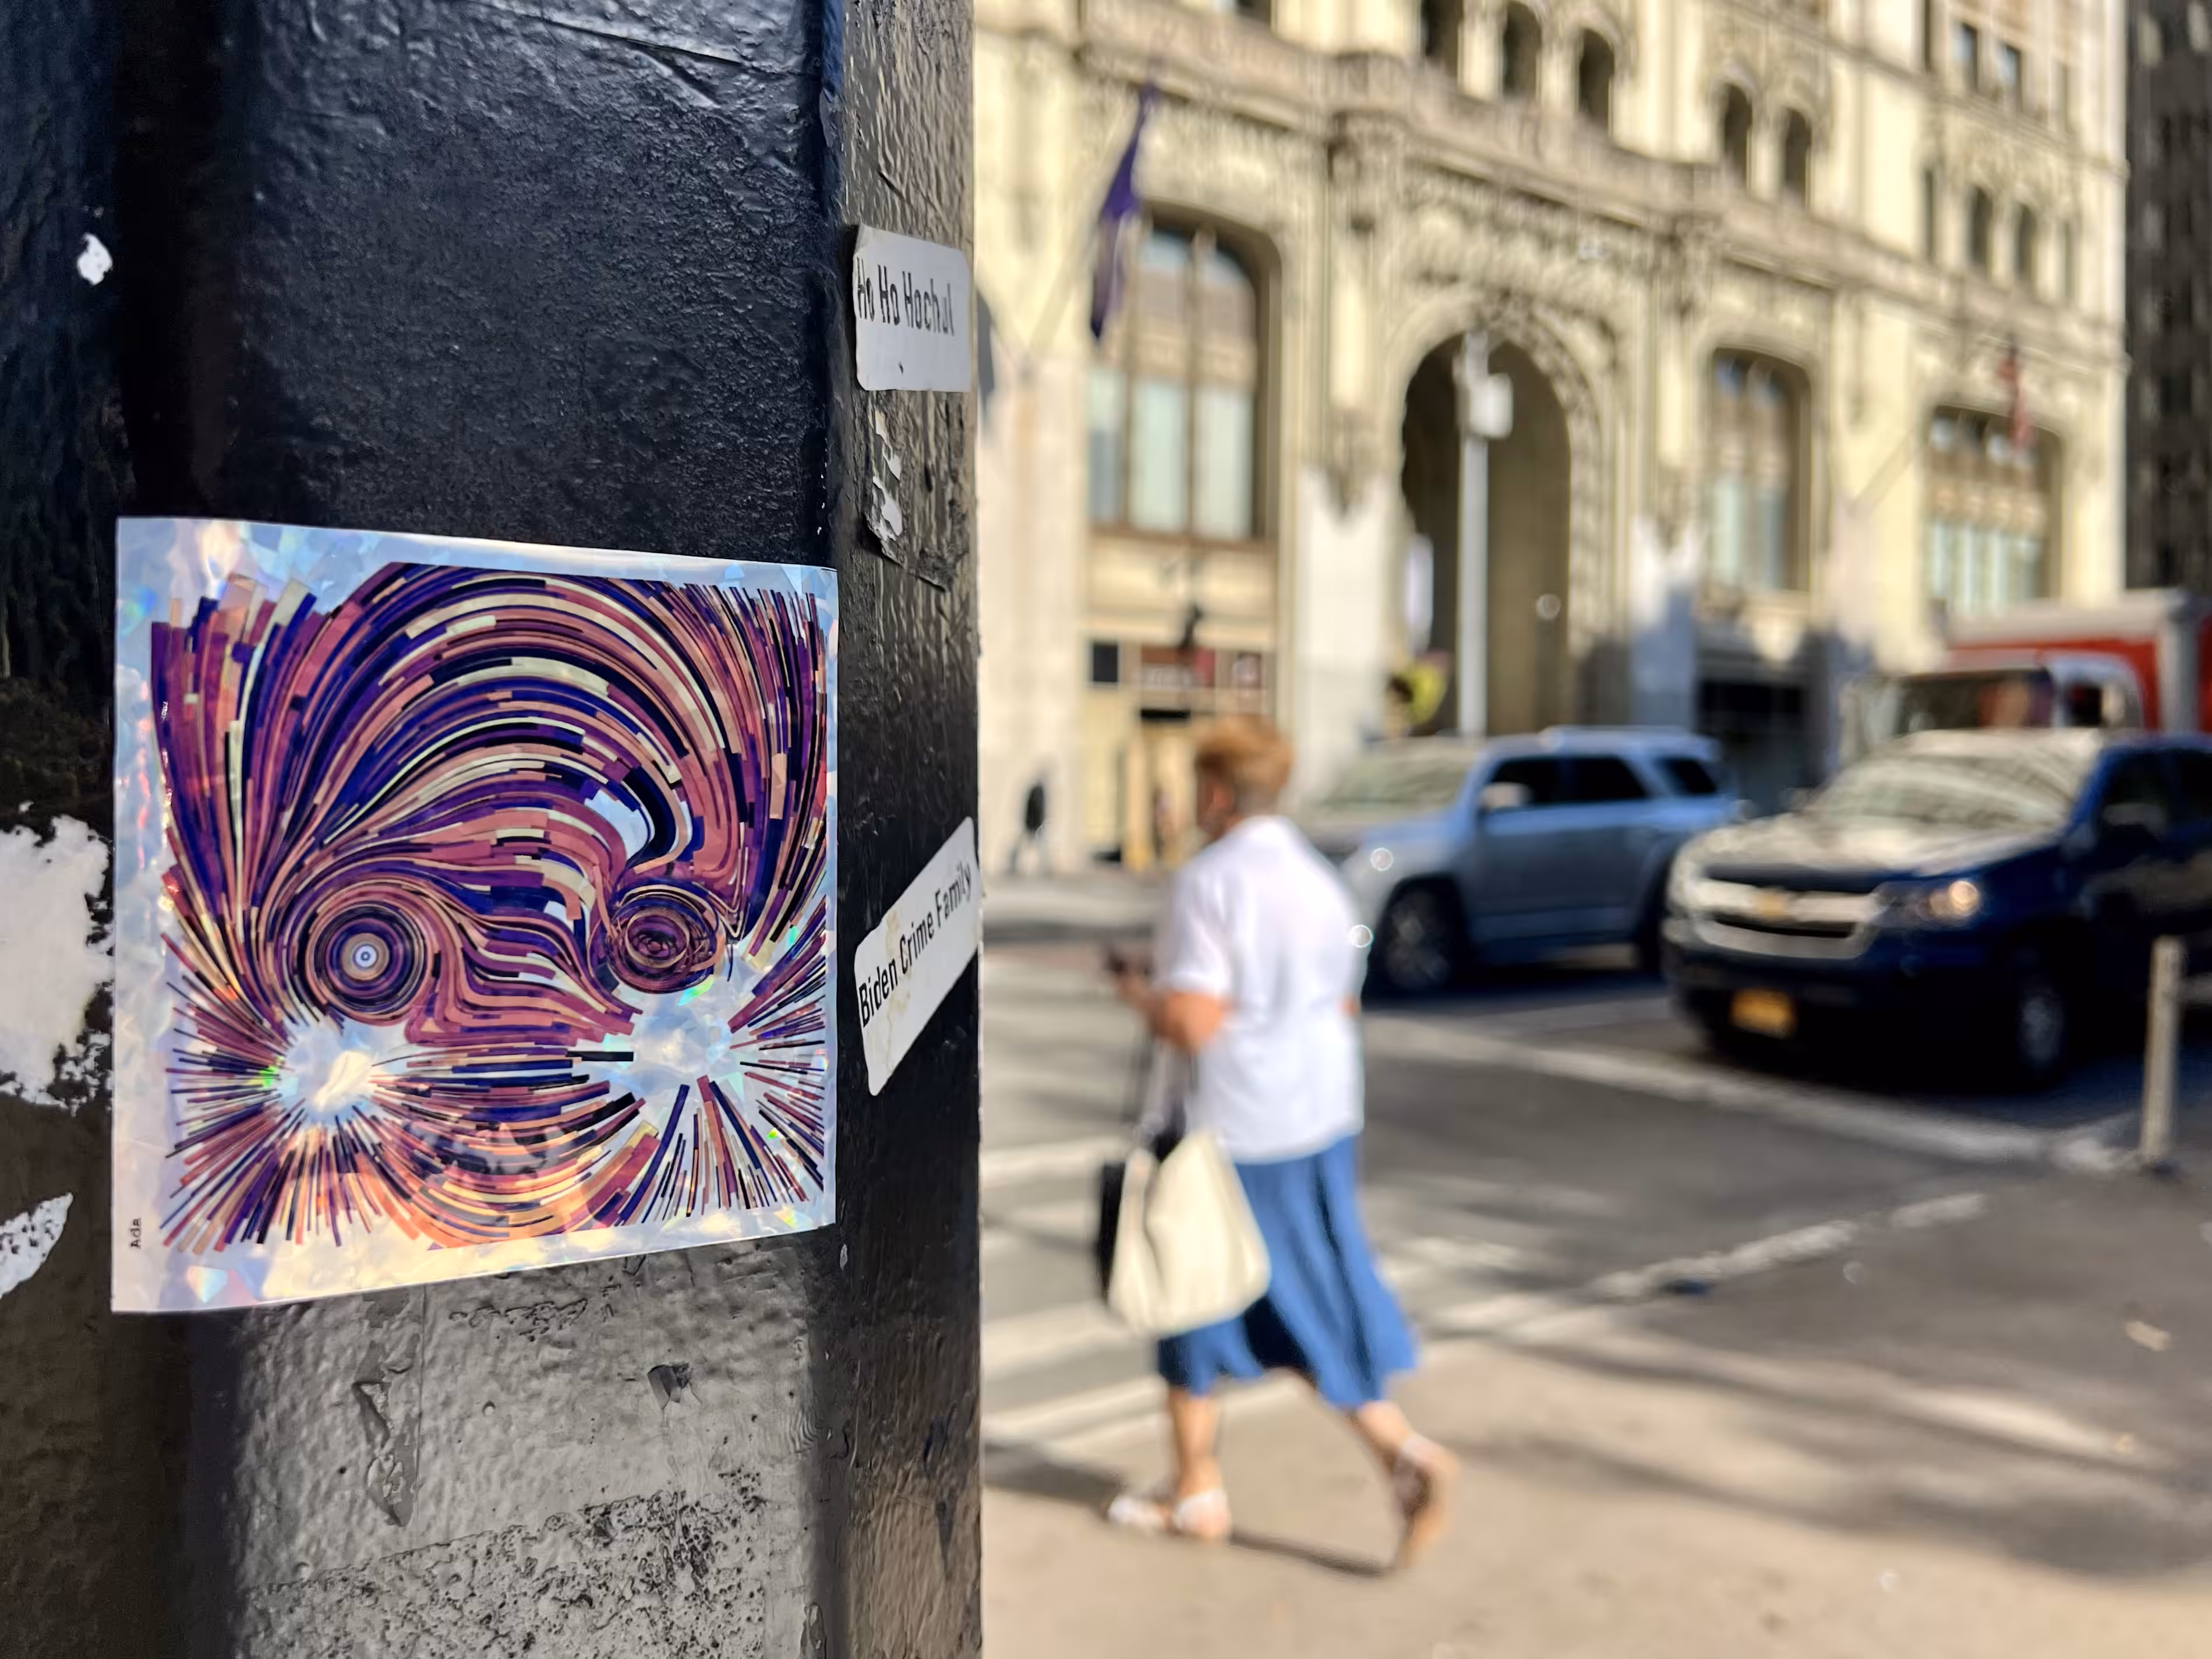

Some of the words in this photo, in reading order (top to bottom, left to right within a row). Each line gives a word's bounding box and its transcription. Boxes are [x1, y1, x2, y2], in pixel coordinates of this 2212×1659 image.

[857, 257, 875, 322] Ho
[878, 264, 900, 326] Ho
[902, 271, 955, 336] Hochul
[858, 957, 898, 1028] Biden
[899, 912, 935, 975] Crime
[935, 860, 971, 929] Family
[130, 1217, 141, 1249] Ada
